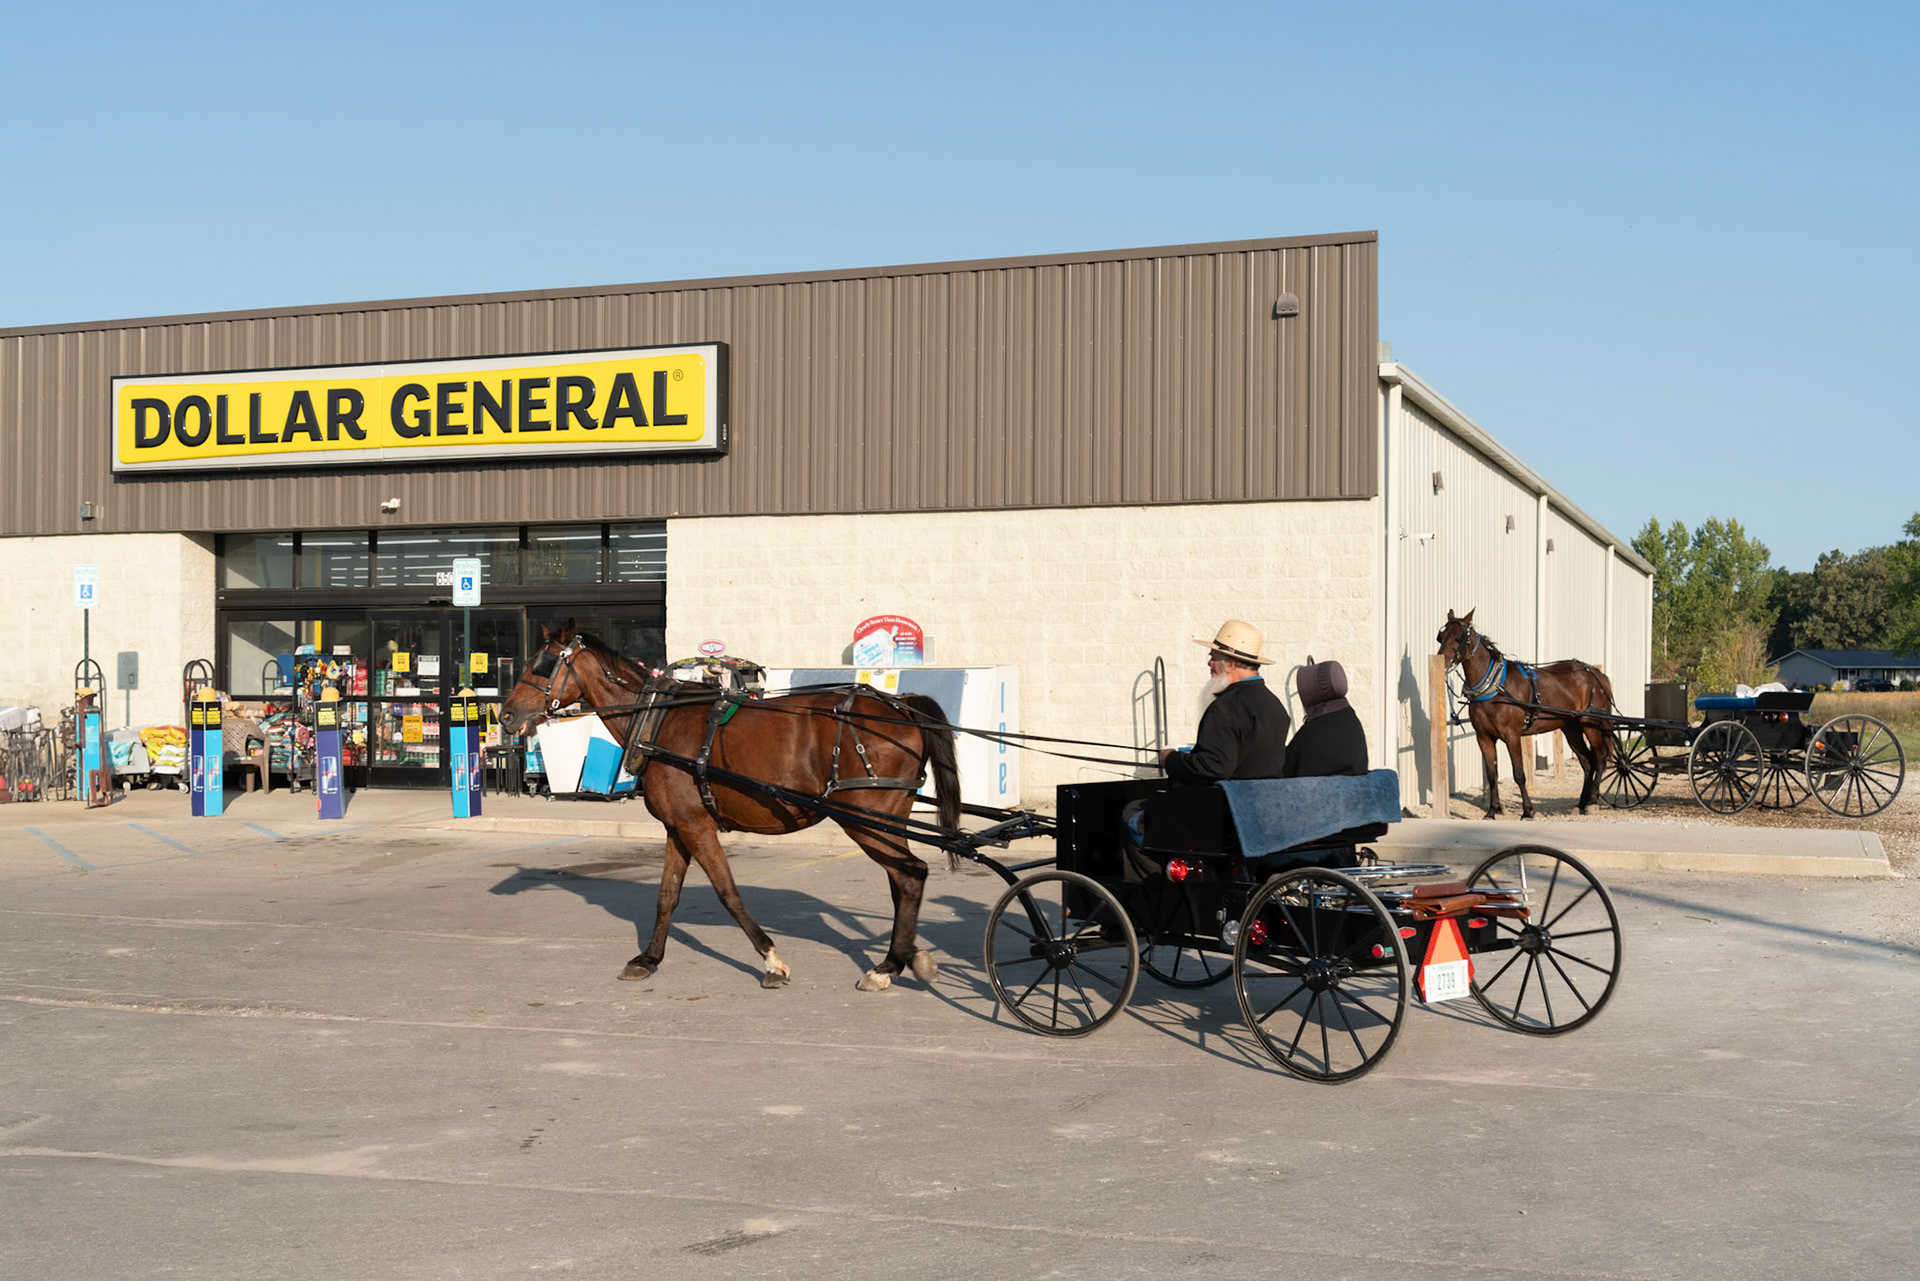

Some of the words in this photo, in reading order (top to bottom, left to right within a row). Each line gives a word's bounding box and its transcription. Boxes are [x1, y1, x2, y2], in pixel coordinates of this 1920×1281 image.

[131, 388, 367, 449] DOLLAR
[390, 370, 688, 439] GENERAL
[1437, 972, 1455, 990] 2739
